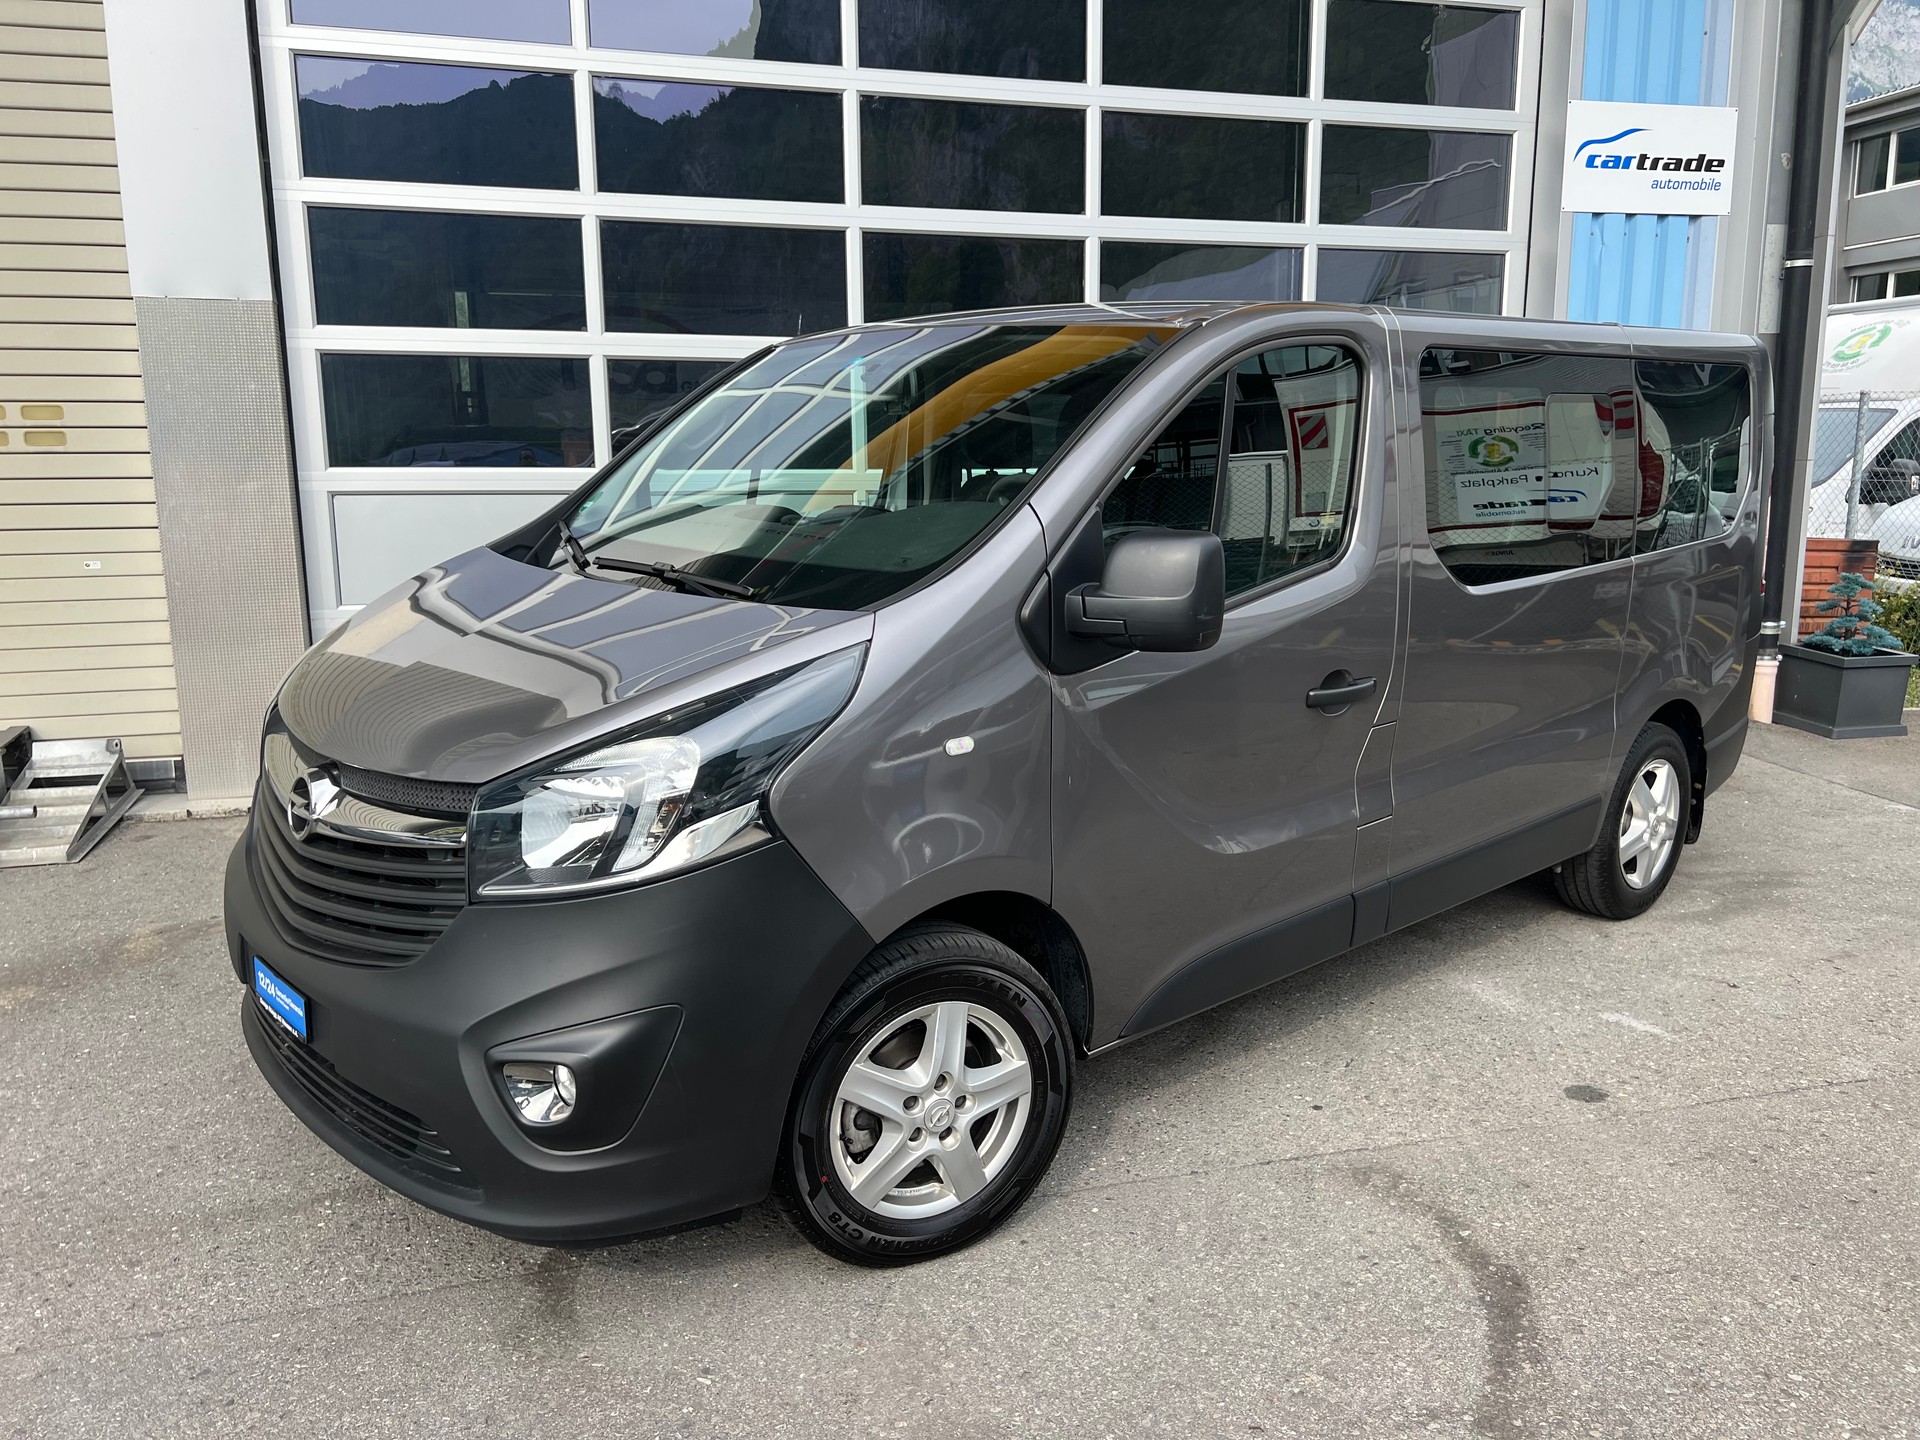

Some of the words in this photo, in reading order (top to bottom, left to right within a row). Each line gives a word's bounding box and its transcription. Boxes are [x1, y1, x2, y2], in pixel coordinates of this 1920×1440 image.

[1585, 153, 1726, 173] cartrade
[1650, 178, 1722, 191] automobile
[940, 973, 1028, 1008] NEXEN
[827, 1211, 864, 1241] CT8
